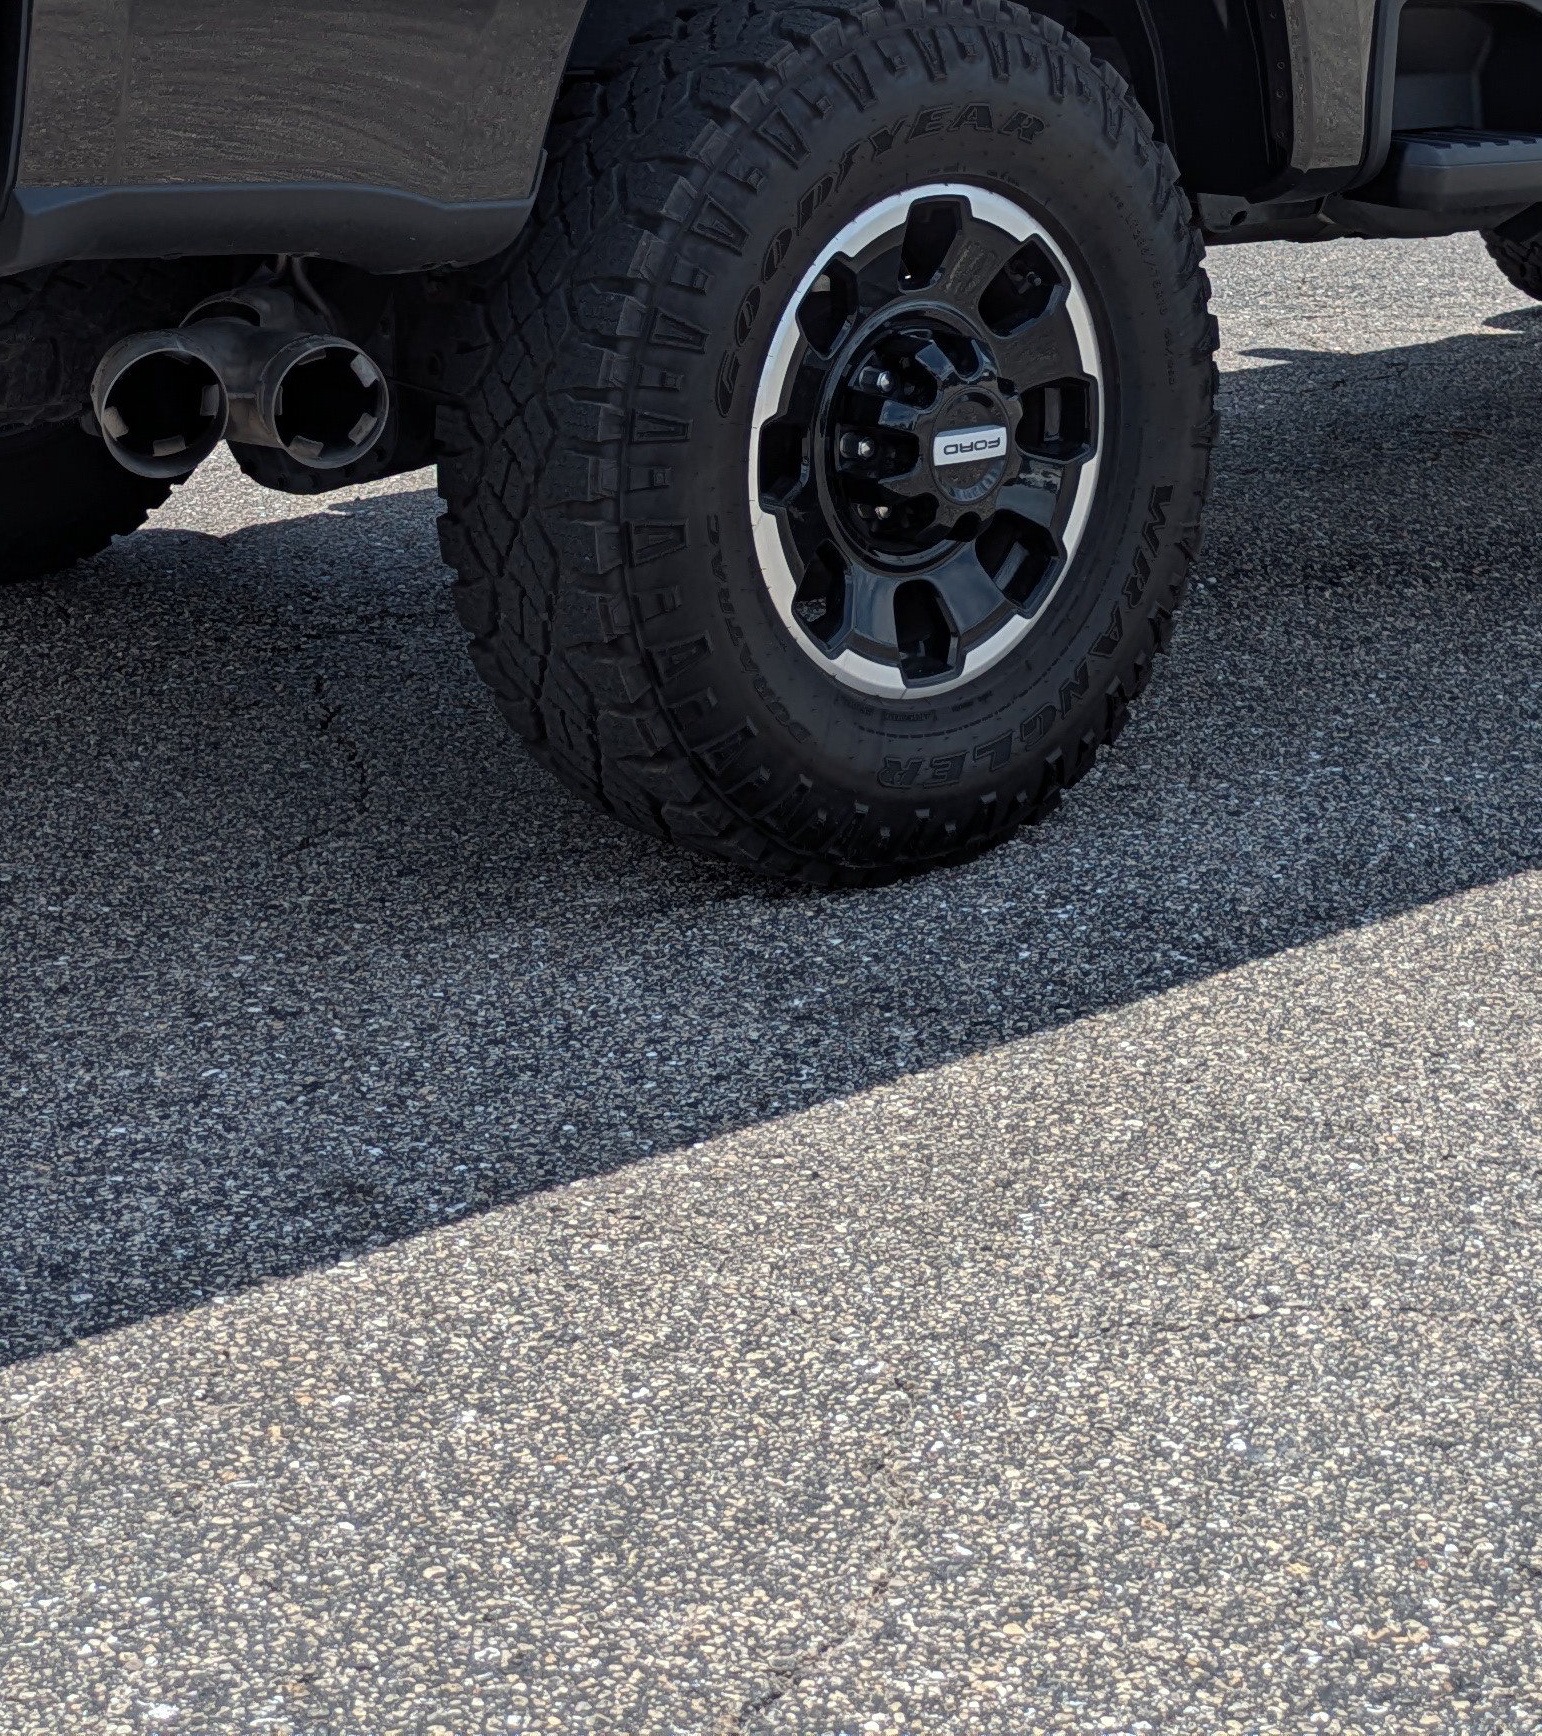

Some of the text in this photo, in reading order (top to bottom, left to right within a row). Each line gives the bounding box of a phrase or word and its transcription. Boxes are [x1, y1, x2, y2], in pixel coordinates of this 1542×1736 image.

[715, 102, 1045, 419] GOODYEAR
[943, 436, 1001, 455] FORD
[706, 514, 813, 744] DURATRAC
[877, 485, 1173, 790] WRANGLER
